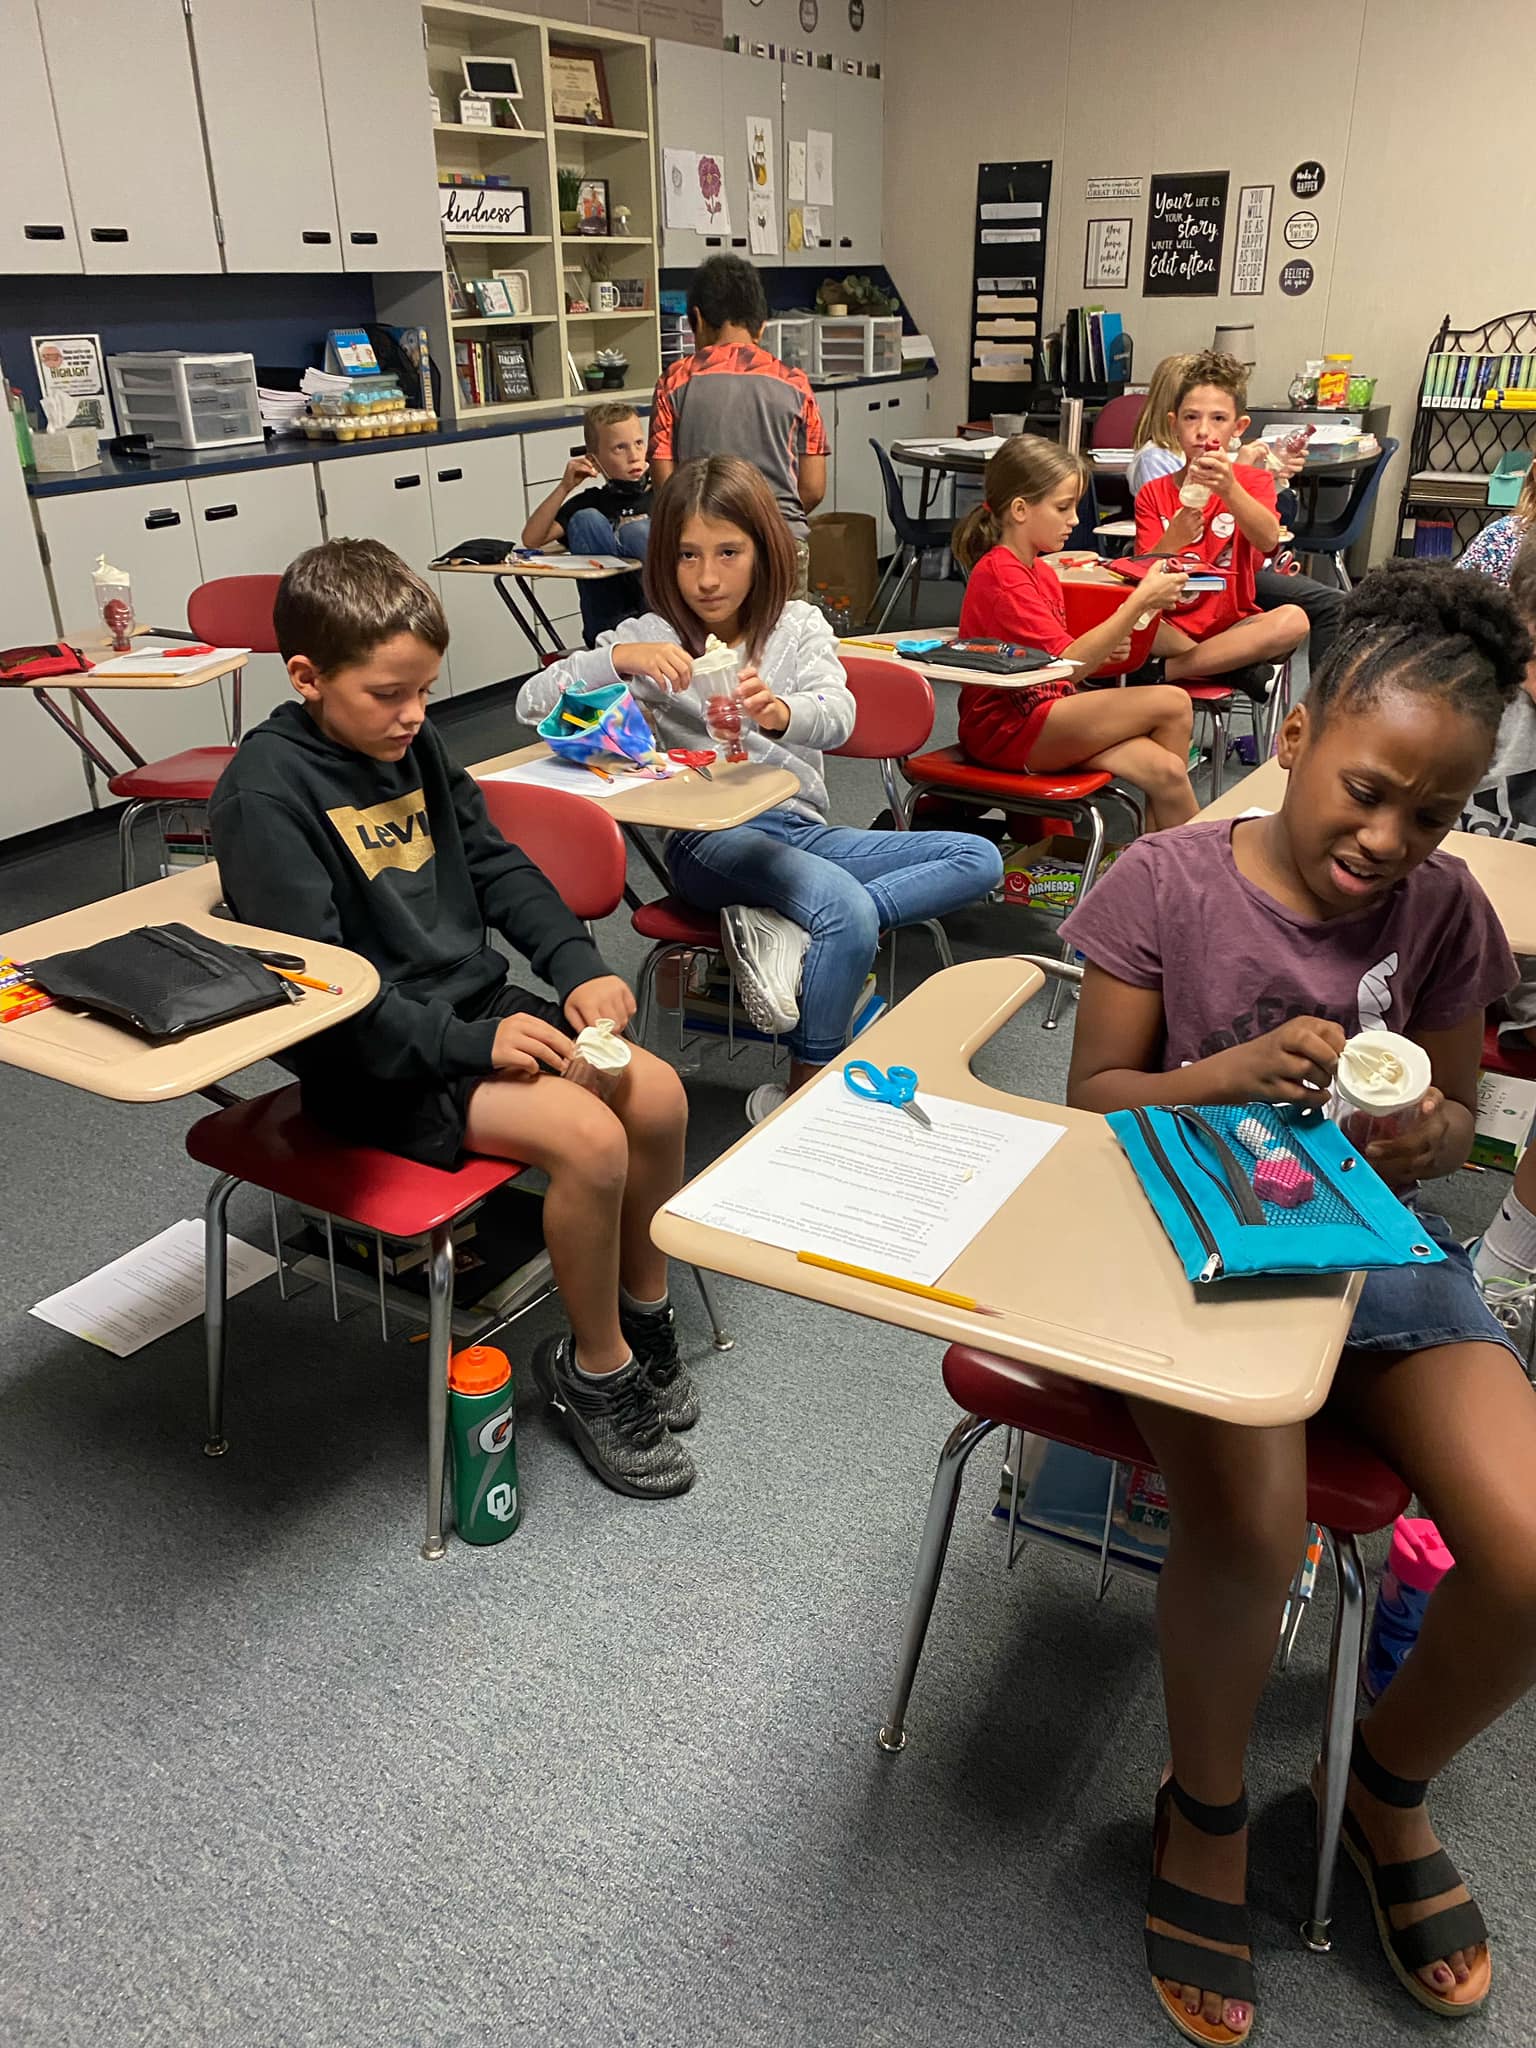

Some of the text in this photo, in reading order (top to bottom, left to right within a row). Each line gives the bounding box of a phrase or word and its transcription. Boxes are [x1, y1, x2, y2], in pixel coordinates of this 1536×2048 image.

[1195, 197, 1208, 207] LIFE
[1211, 196, 1221, 207] IS
[1250, 190, 1264, 204] YOU
[441, 190, 525, 223] kindness
[1247, 205, 1262, 219] WILL
[1165, 213, 1184, 223] YOUR
[1243, 219, 1264, 234] BE AS
[1151, 240, 1173, 250] WRITE
[1241, 234, 1264, 248] HAPPY
[1239, 248, 1264, 262] AS YOU
[1149, 251, 1179, 278] Edit
[1238, 263, 1262, 277] DECIDE
[1284, 267, 1311, 279] BELIEVE
[50, 367, 90, 379] HIGHLIGHT
[1028, 880, 1076, 896] AIRHEADS
[486, 1481, 517, 1523] OU
